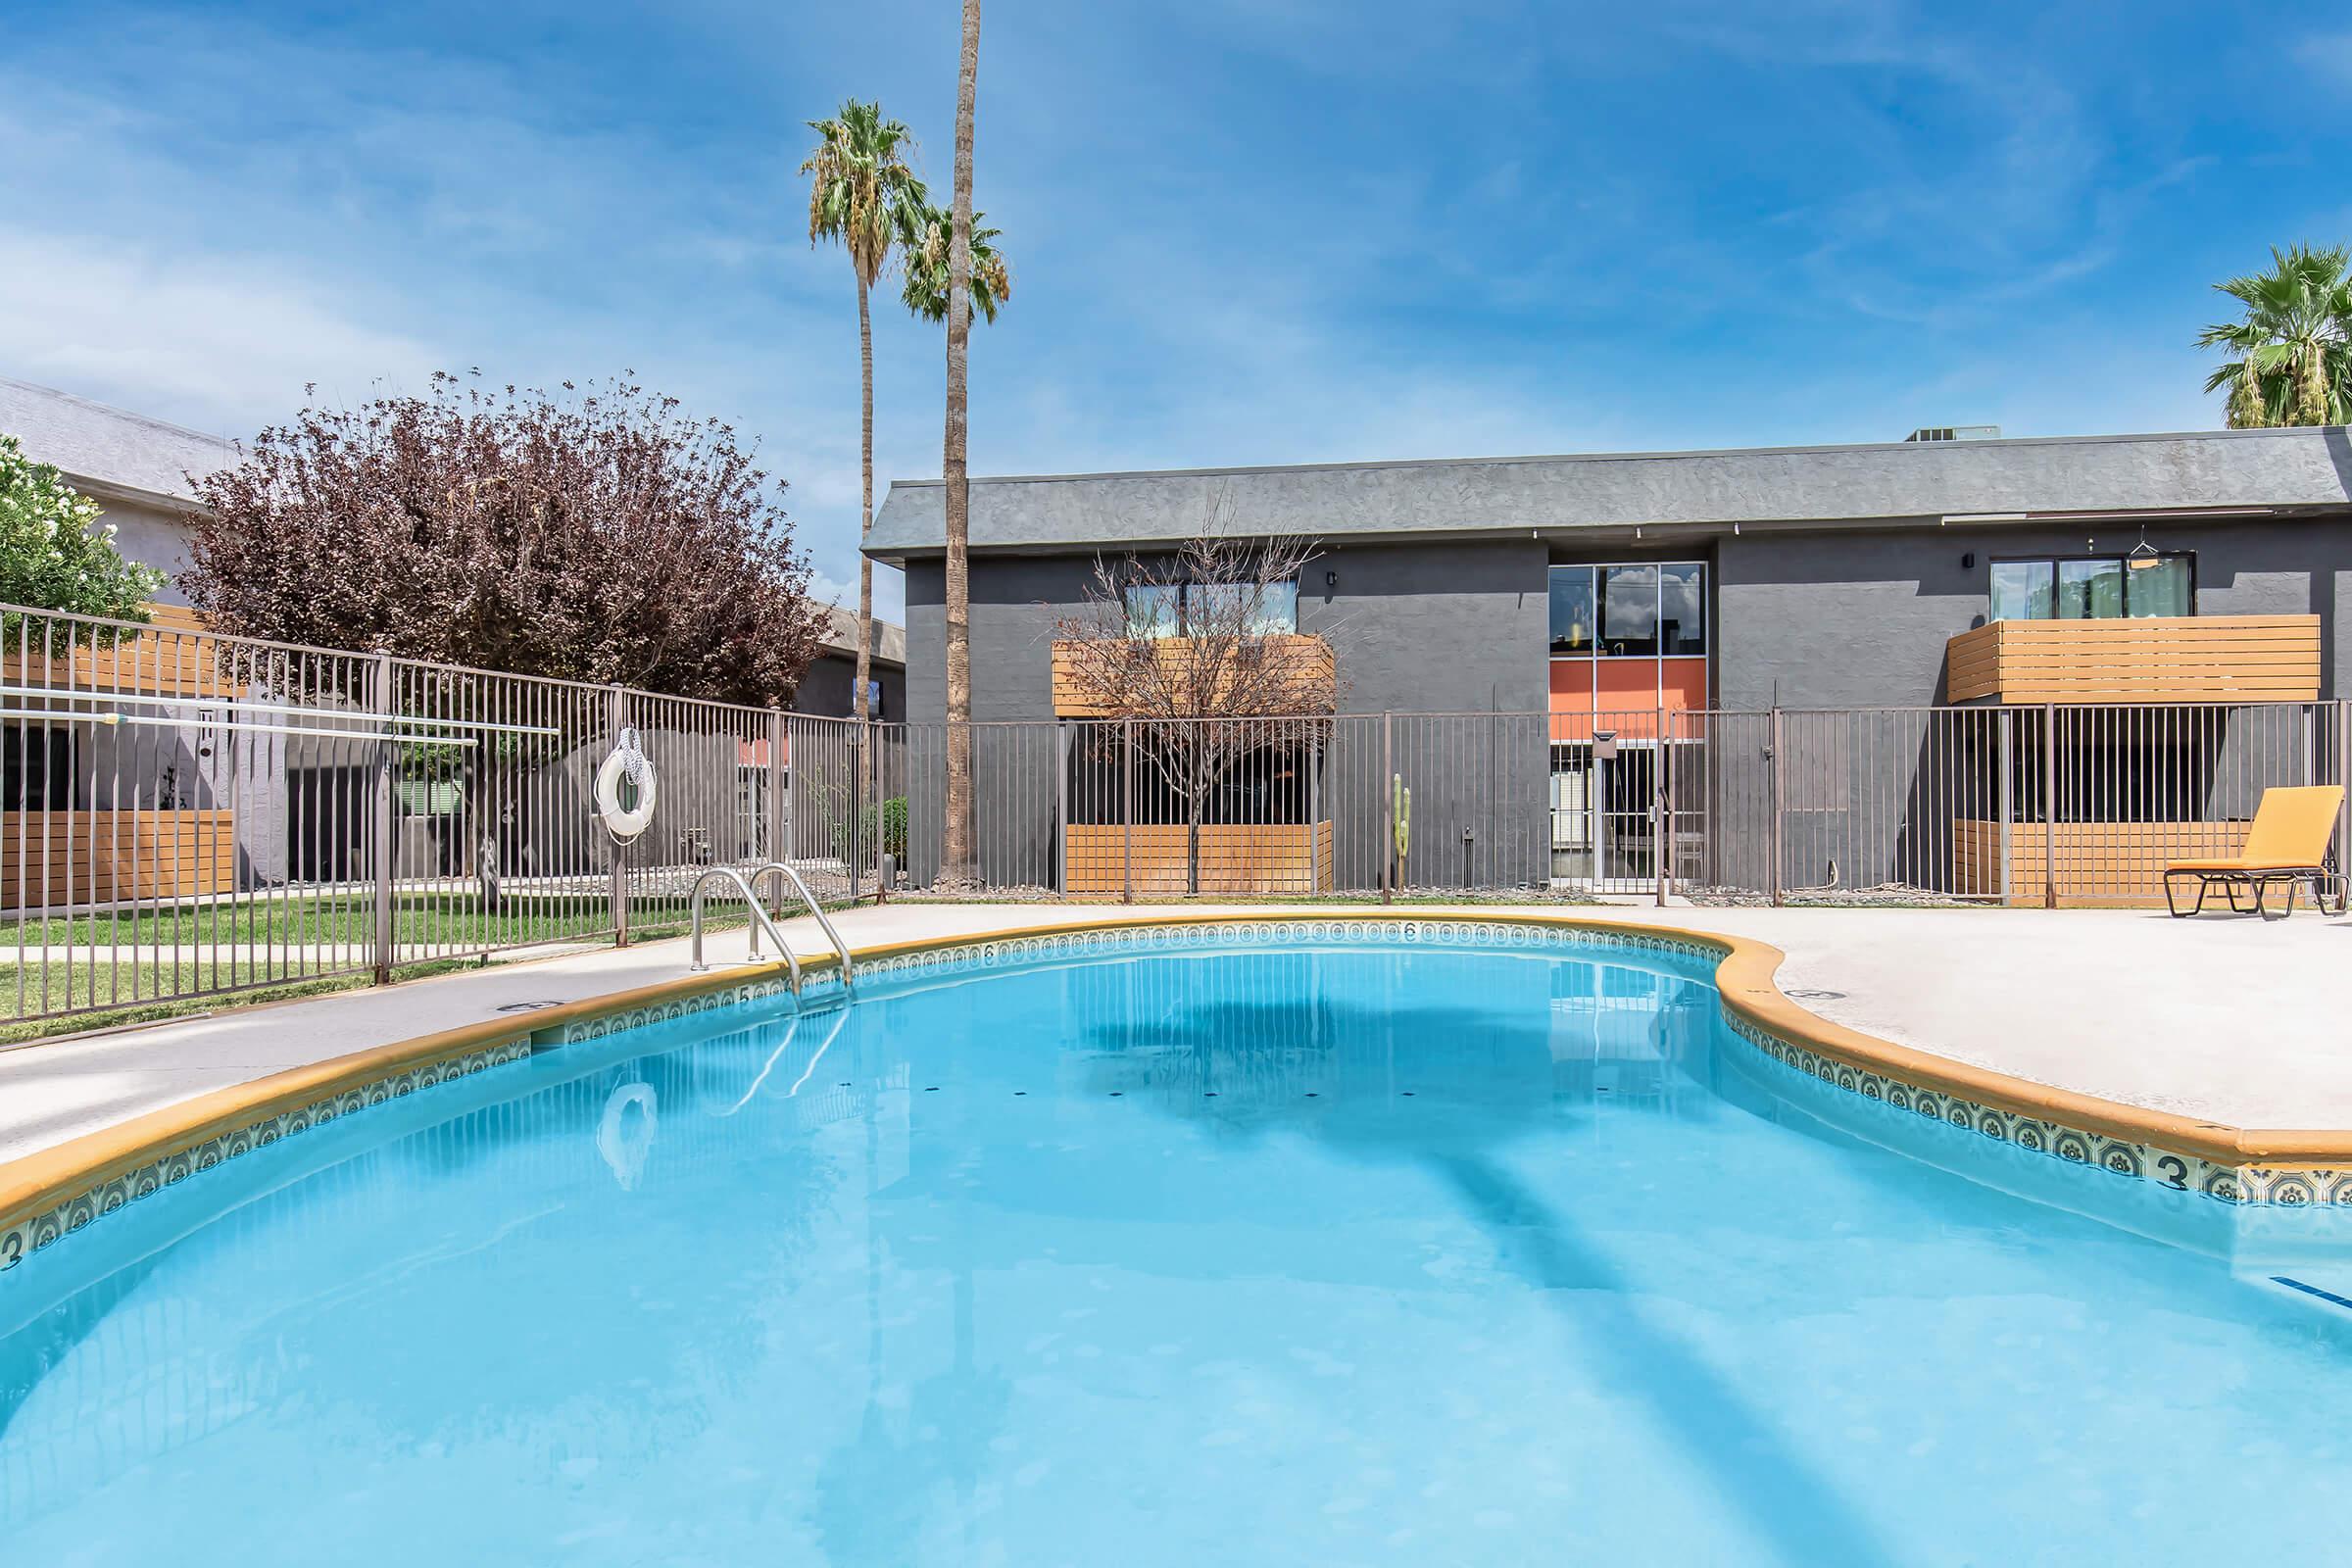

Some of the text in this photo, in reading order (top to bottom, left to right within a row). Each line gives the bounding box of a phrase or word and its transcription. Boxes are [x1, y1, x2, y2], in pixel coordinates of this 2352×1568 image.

[1404, 922, 1416, 935] 6
[985, 944, 994, 959] 6
[2156, 1155, 2188, 1191] 3
[0, 1231, 23, 1272] 3
